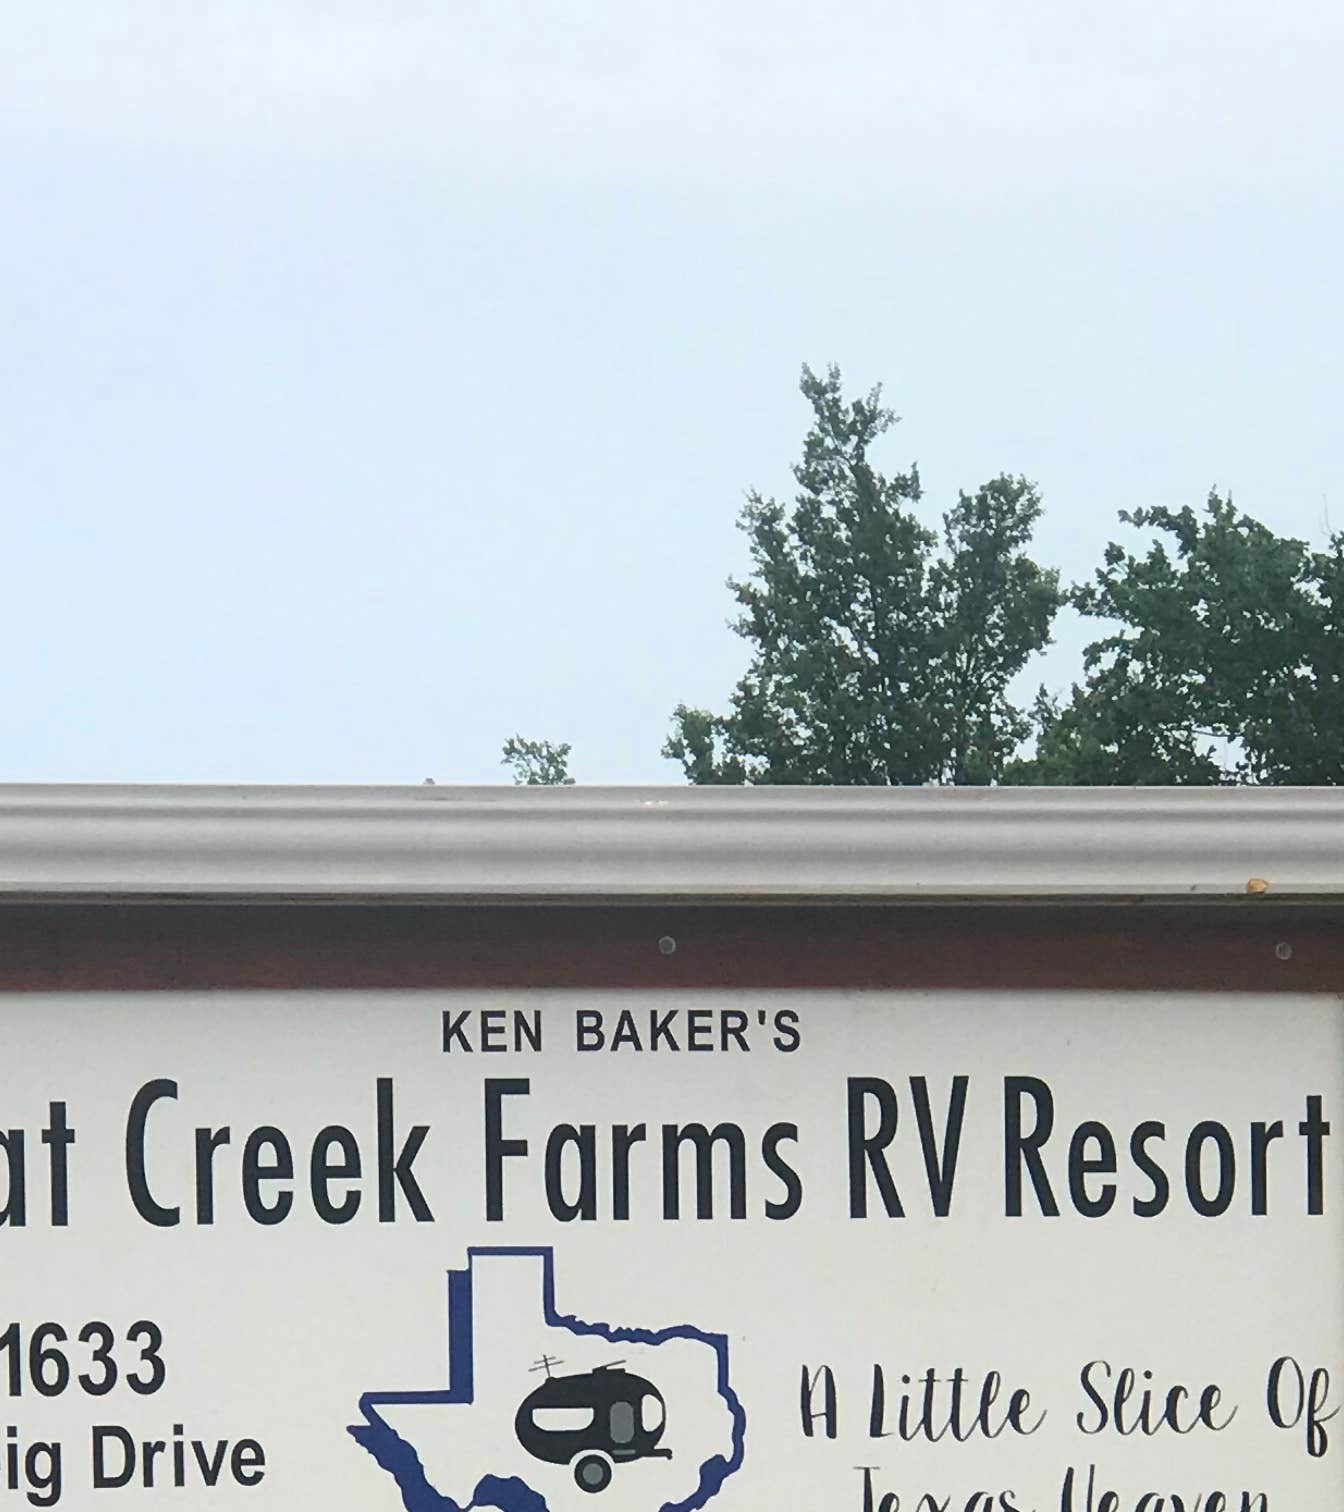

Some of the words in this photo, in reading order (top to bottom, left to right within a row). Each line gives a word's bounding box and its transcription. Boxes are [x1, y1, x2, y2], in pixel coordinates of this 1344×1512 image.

[442, 1009, 542, 1053] KEN
[576, 1009, 801, 1053] BAKER'S
[125, 1077, 436, 1228] Creek
[484, 1077, 803, 1222] Farms
[846, 1075, 970, 1219] RV
[1003, 1075, 1332, 1218] Resort
[799, 1361, 840, 1440] A
[868, 1362, 1048, 1443] Little
[1074, 1360, 1238, 1437] Slice
[1265, 1355, 1342, 1459] Of
[91, 1423, 266, 1489] Drive
